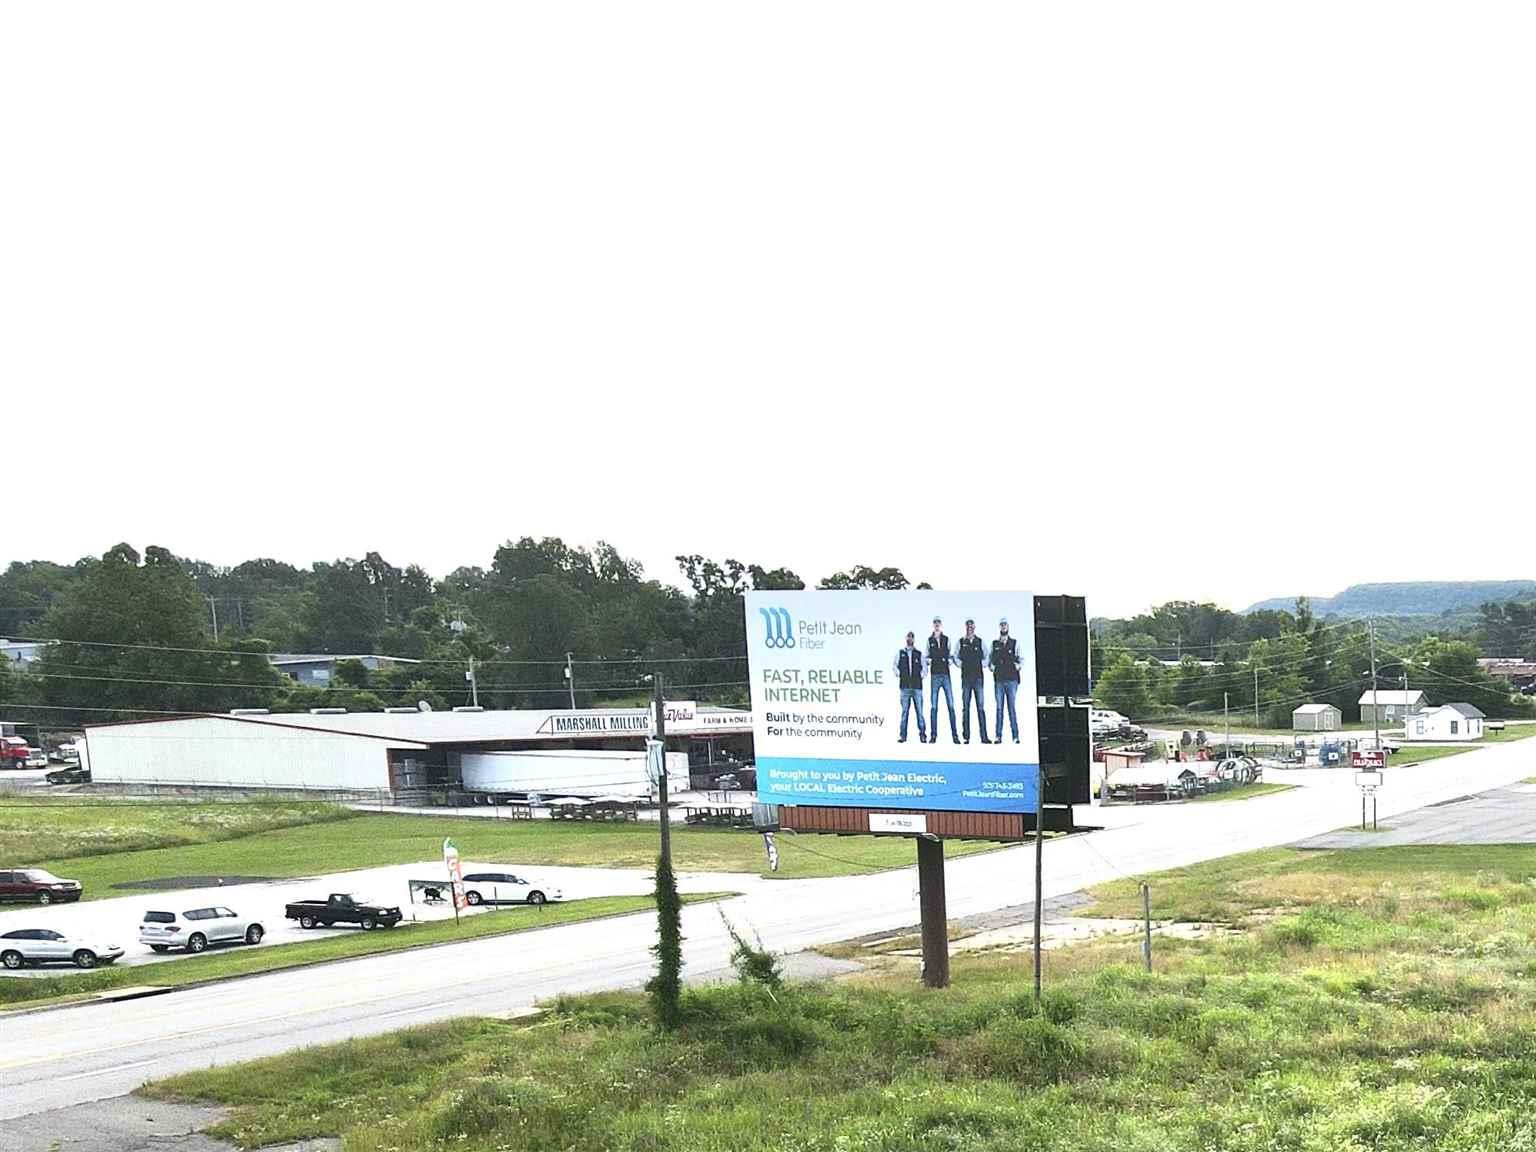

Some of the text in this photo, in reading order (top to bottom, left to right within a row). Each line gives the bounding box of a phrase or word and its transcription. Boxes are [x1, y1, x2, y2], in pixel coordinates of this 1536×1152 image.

[798, 620, 862, 635] Petit Jean
[799, 637, 825, 649] Fiber
[762, 669, 884, 686] FAST, RELIABLE
[764, 688, 841, 703] INTERNET
[556, 715, 649, 731] MARSHALL MILLING
[766, 712, 790, 722] Built
[792, 713, 805, 725] by
[807, 713, 824, 723] the
[826, 714, 884, 727] community
[767, 726, 862, 740] For the community
[769, 769, 947, 785] Brought to you by Petit Jean Electric,
[770, 783, 924, 796] your LOCAL Electric Cooperative
